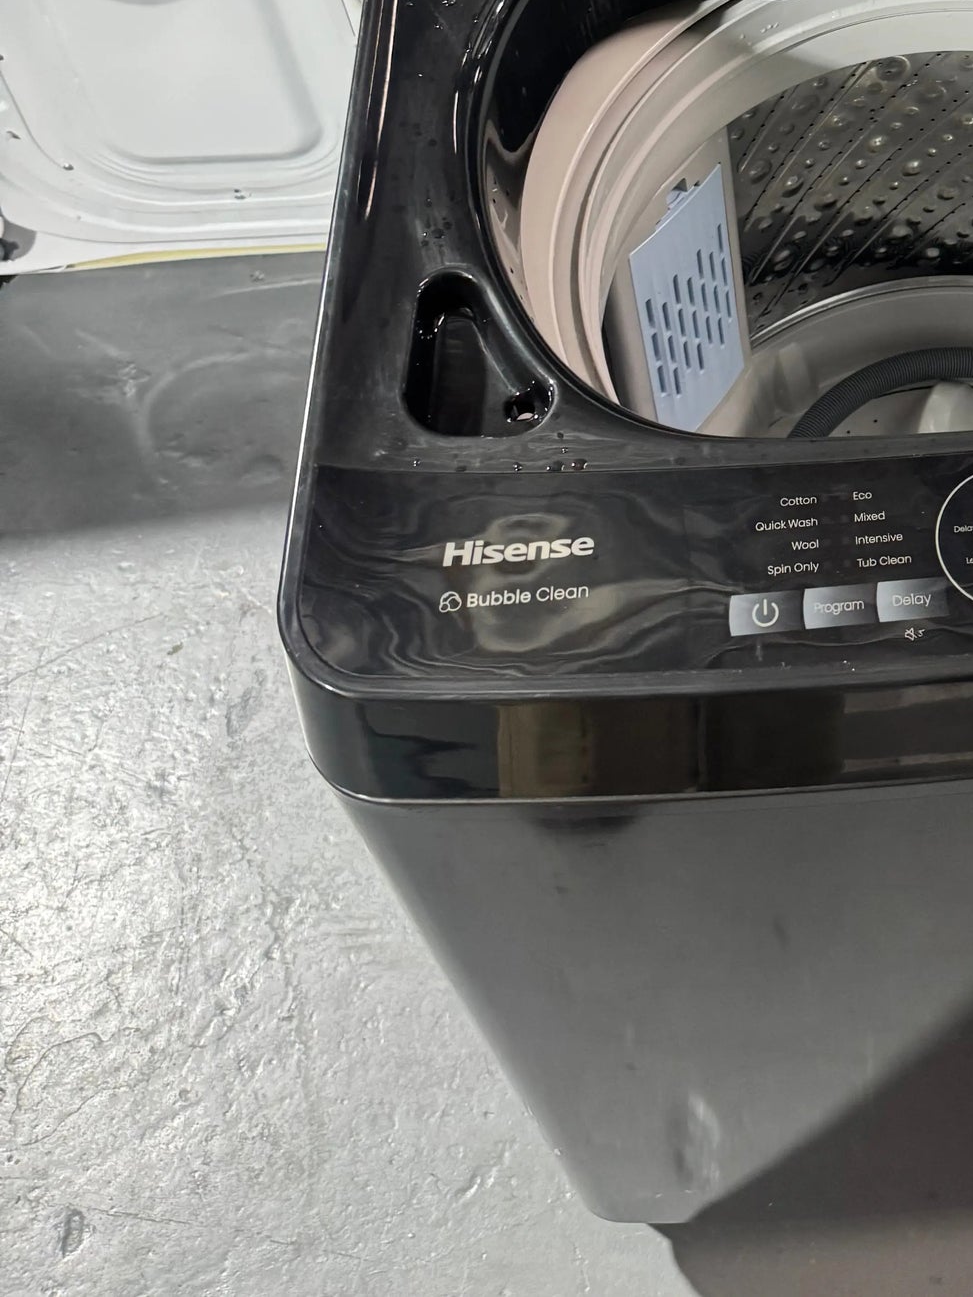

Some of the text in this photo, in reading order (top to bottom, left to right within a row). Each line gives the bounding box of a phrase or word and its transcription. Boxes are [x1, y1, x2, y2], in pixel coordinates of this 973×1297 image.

[780, 496, 818, 507] Cotton
[852, 491, 873, 501] Eco
[854, 511, 886, 523] Mixed
[755, 517, 818, 532] Quick Wash
[791, 539, 819, 551] Wool
[855, 533, 903, 545] Intensive
[442, 536, 595, 567] Hisense
[857, 554, 912, 568] Tub Clean
[767, 562, 819, 577] Spin Only
[466, 585, 589, 608] Bubble Clean
[892, 593, 931, 607] Delay
[814, 599, 865, 615] Program
